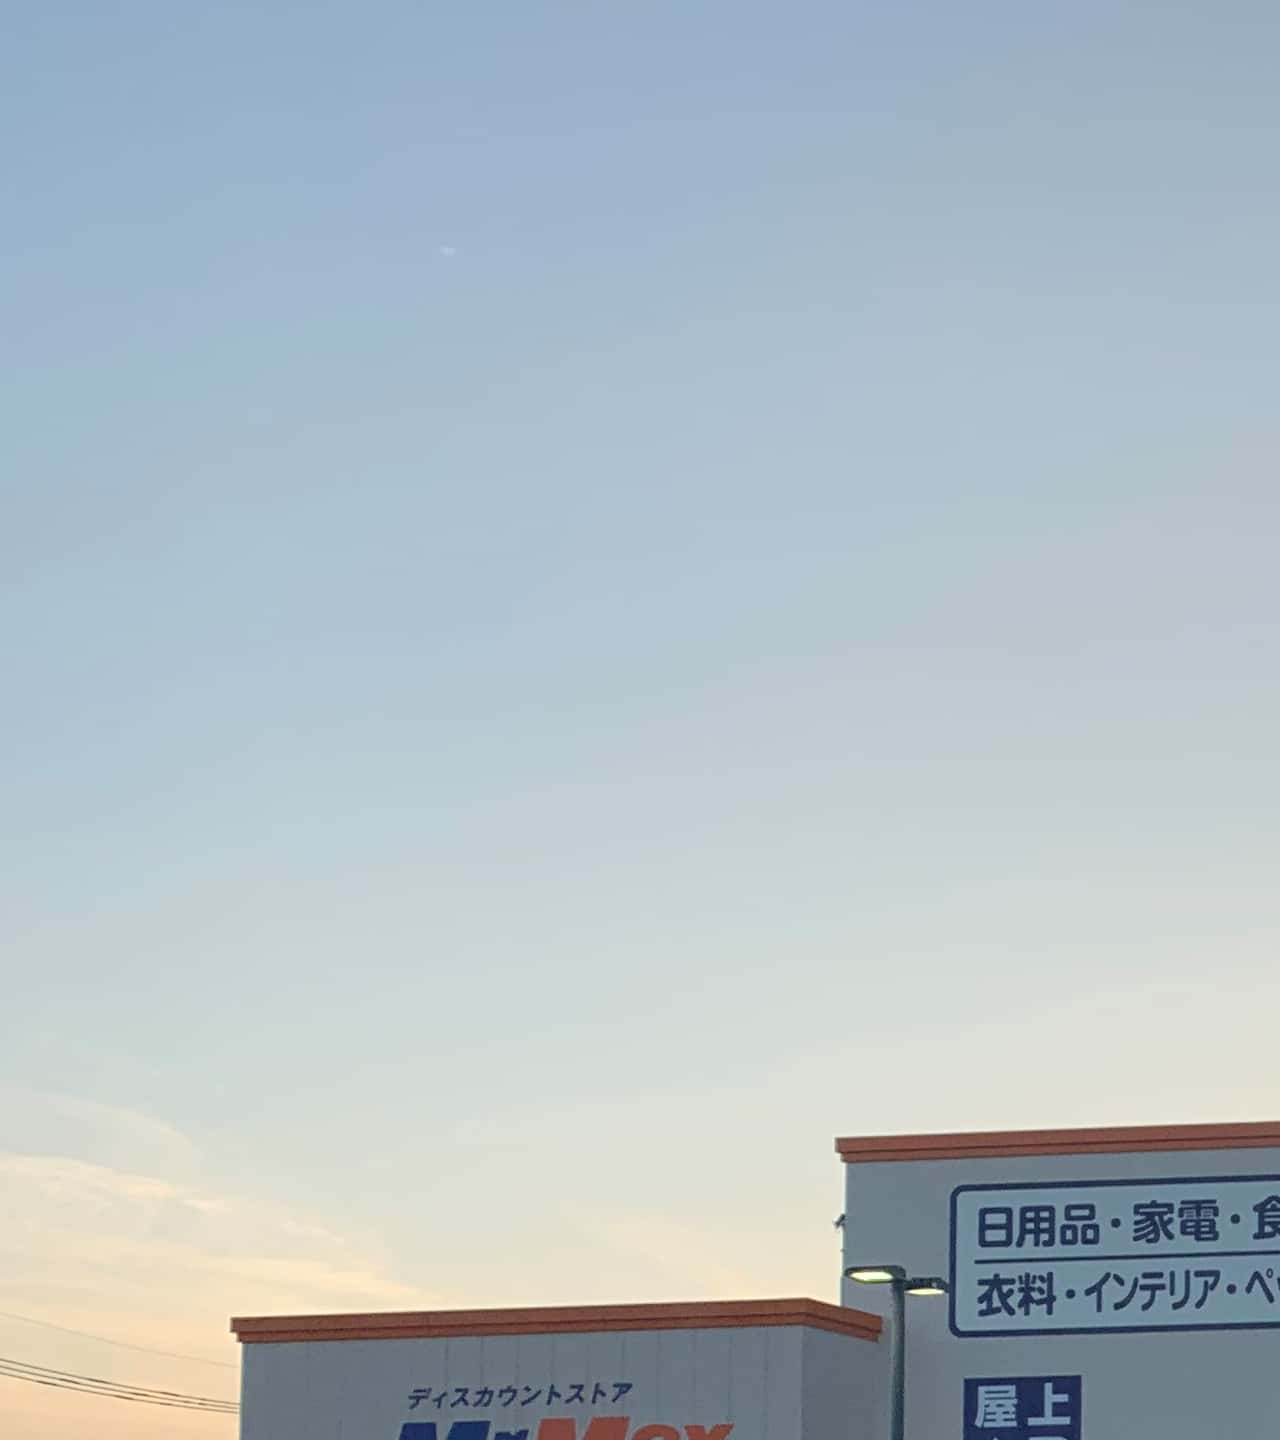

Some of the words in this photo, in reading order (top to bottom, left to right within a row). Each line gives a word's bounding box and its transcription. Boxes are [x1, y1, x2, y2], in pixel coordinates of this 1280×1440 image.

[407, 1382, 634, 1410] ディスカウントストア
[974, 1382, 1071, 1428] 屋上
